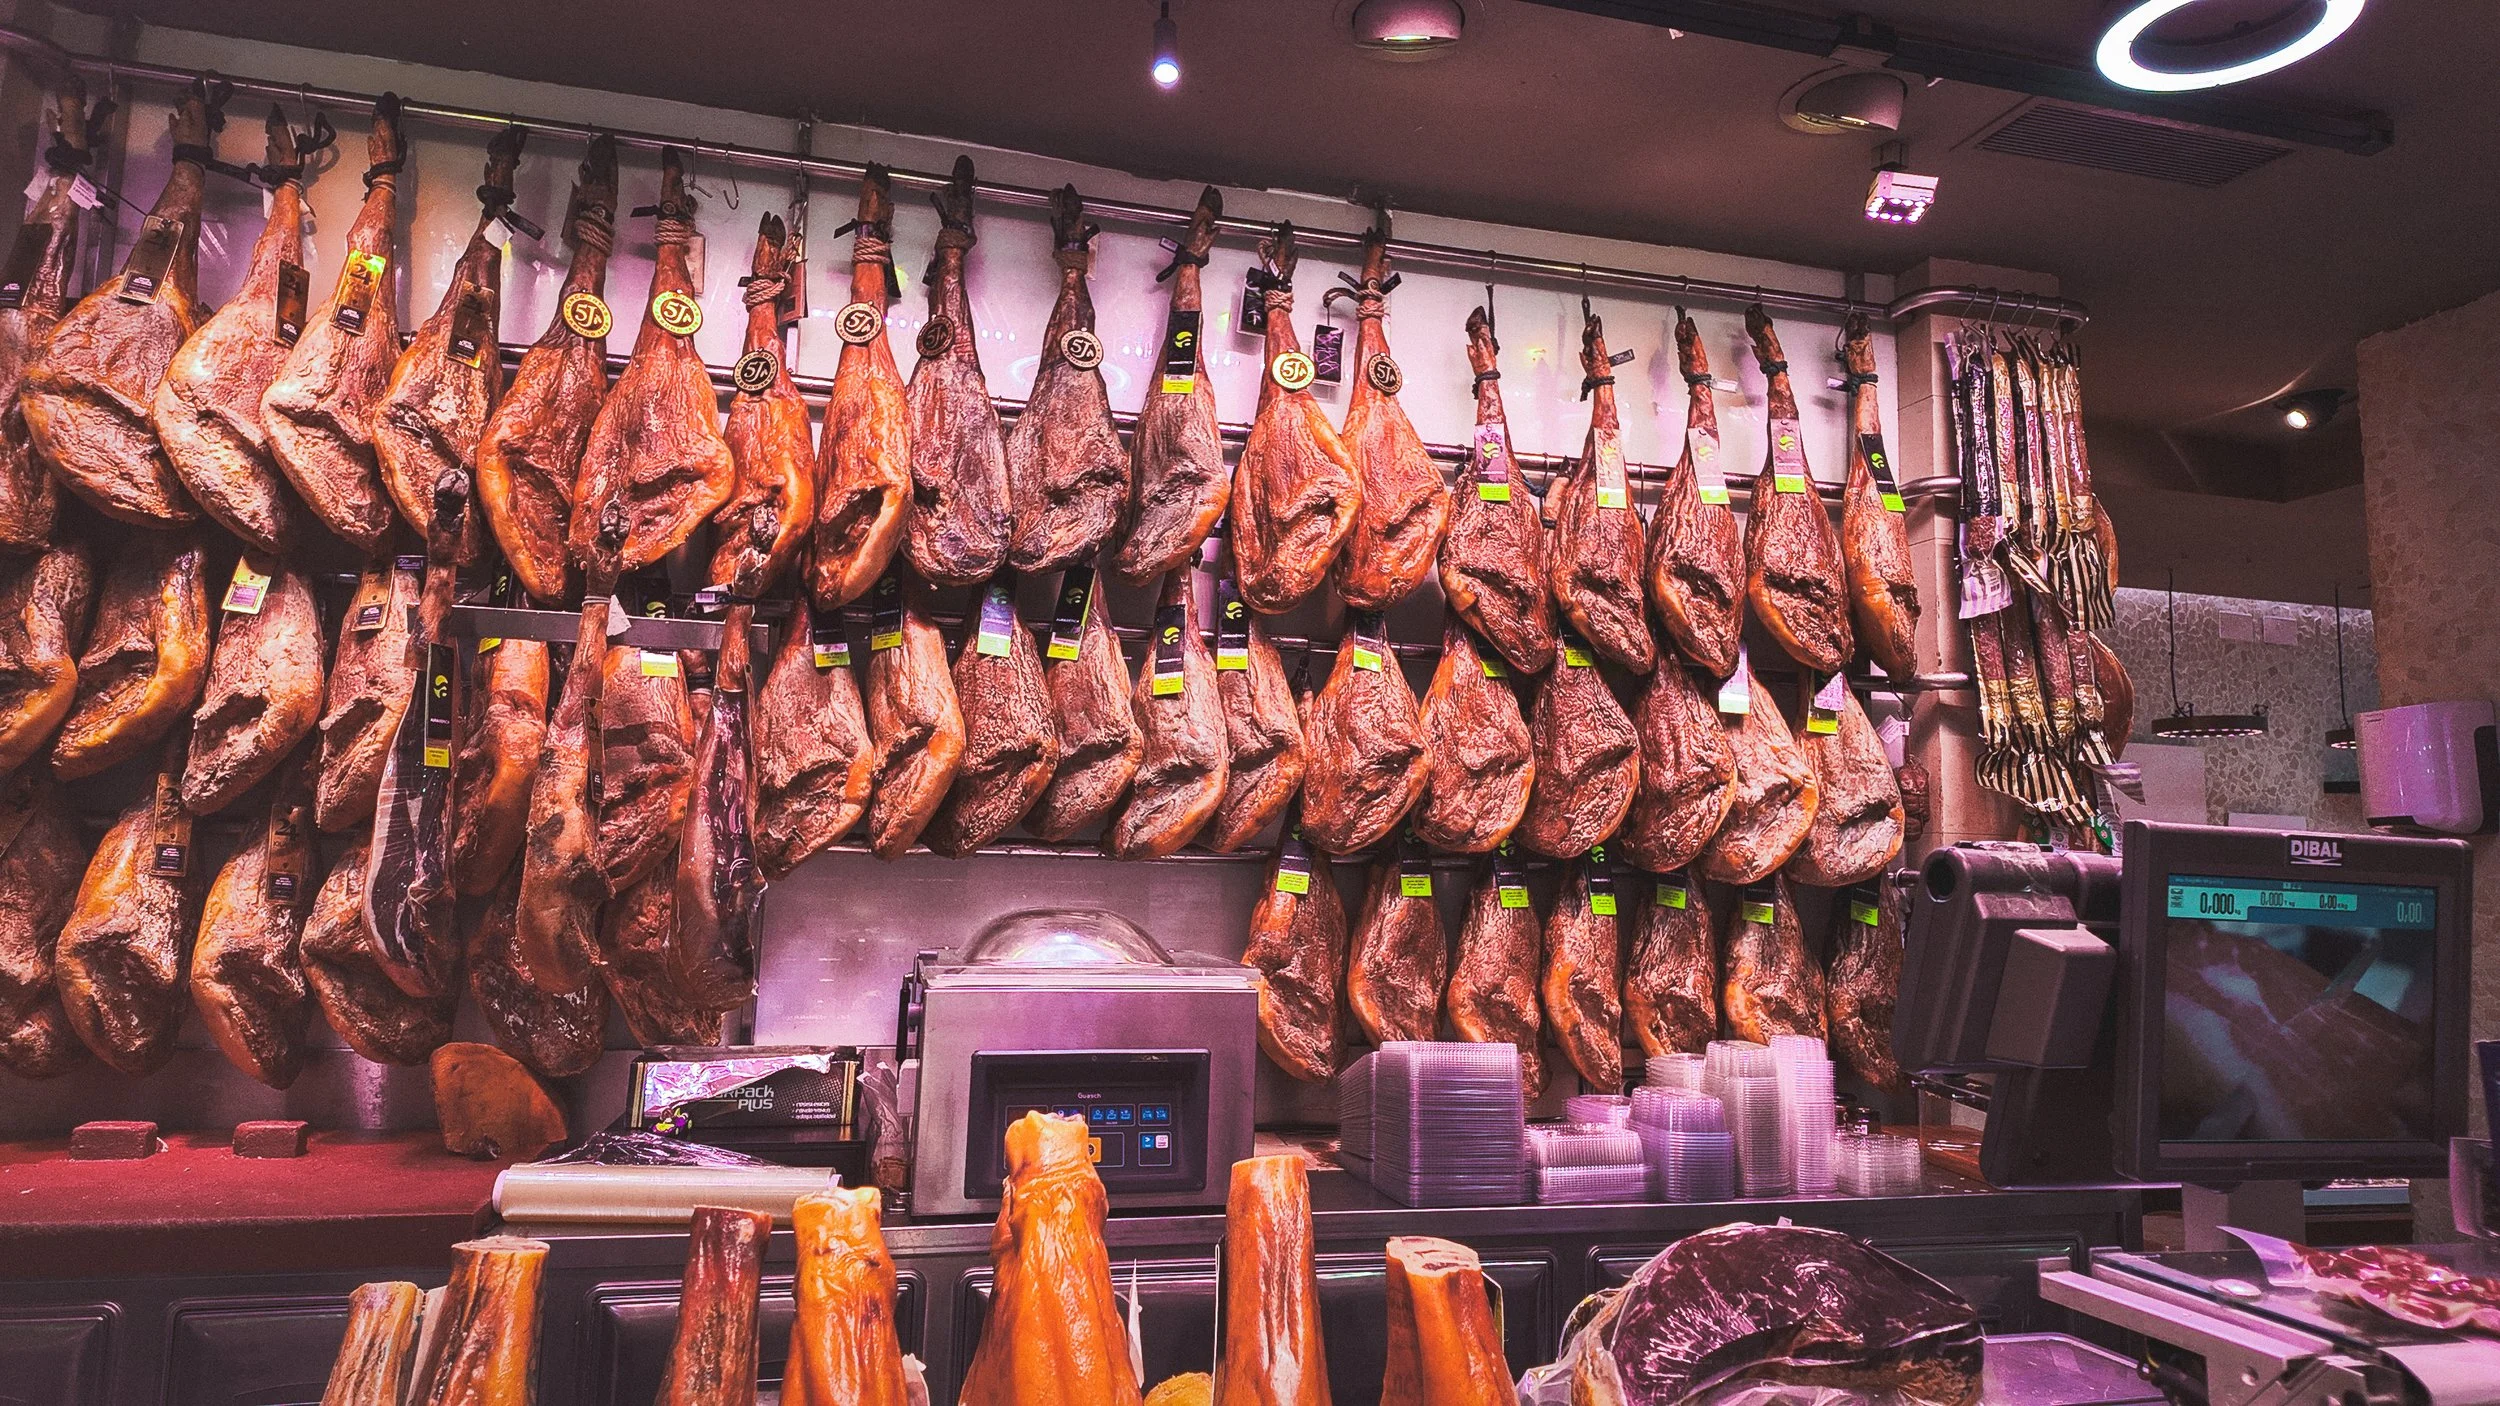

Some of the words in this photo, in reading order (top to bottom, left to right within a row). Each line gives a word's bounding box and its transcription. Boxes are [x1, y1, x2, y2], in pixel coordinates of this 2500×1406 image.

[350, 263, 373, 285] 24
[574, 303, 598, 328] 5J
[663, 301, 690, 324] 5J
[845, 312, 872, 333] 5J
[1070, 339, 1093, 358] 5J
[743, 360, 767, 383] 5J
[1282, 361, 1302, 381] 5J
[1377, 364, 1392, 384] 5J
[275, 818, 298, 842] 24
[2290, 840, 2342, 858] DIBAL
[2199, 892, 2235, 915] 0,000
[2260, 891, 2284, 907] 0,000
[2319, 894, 2337, 909] 0,00
[2397, 901, 2422, 923] 0,00
[737, 1099, 773, 1112] PLUS
